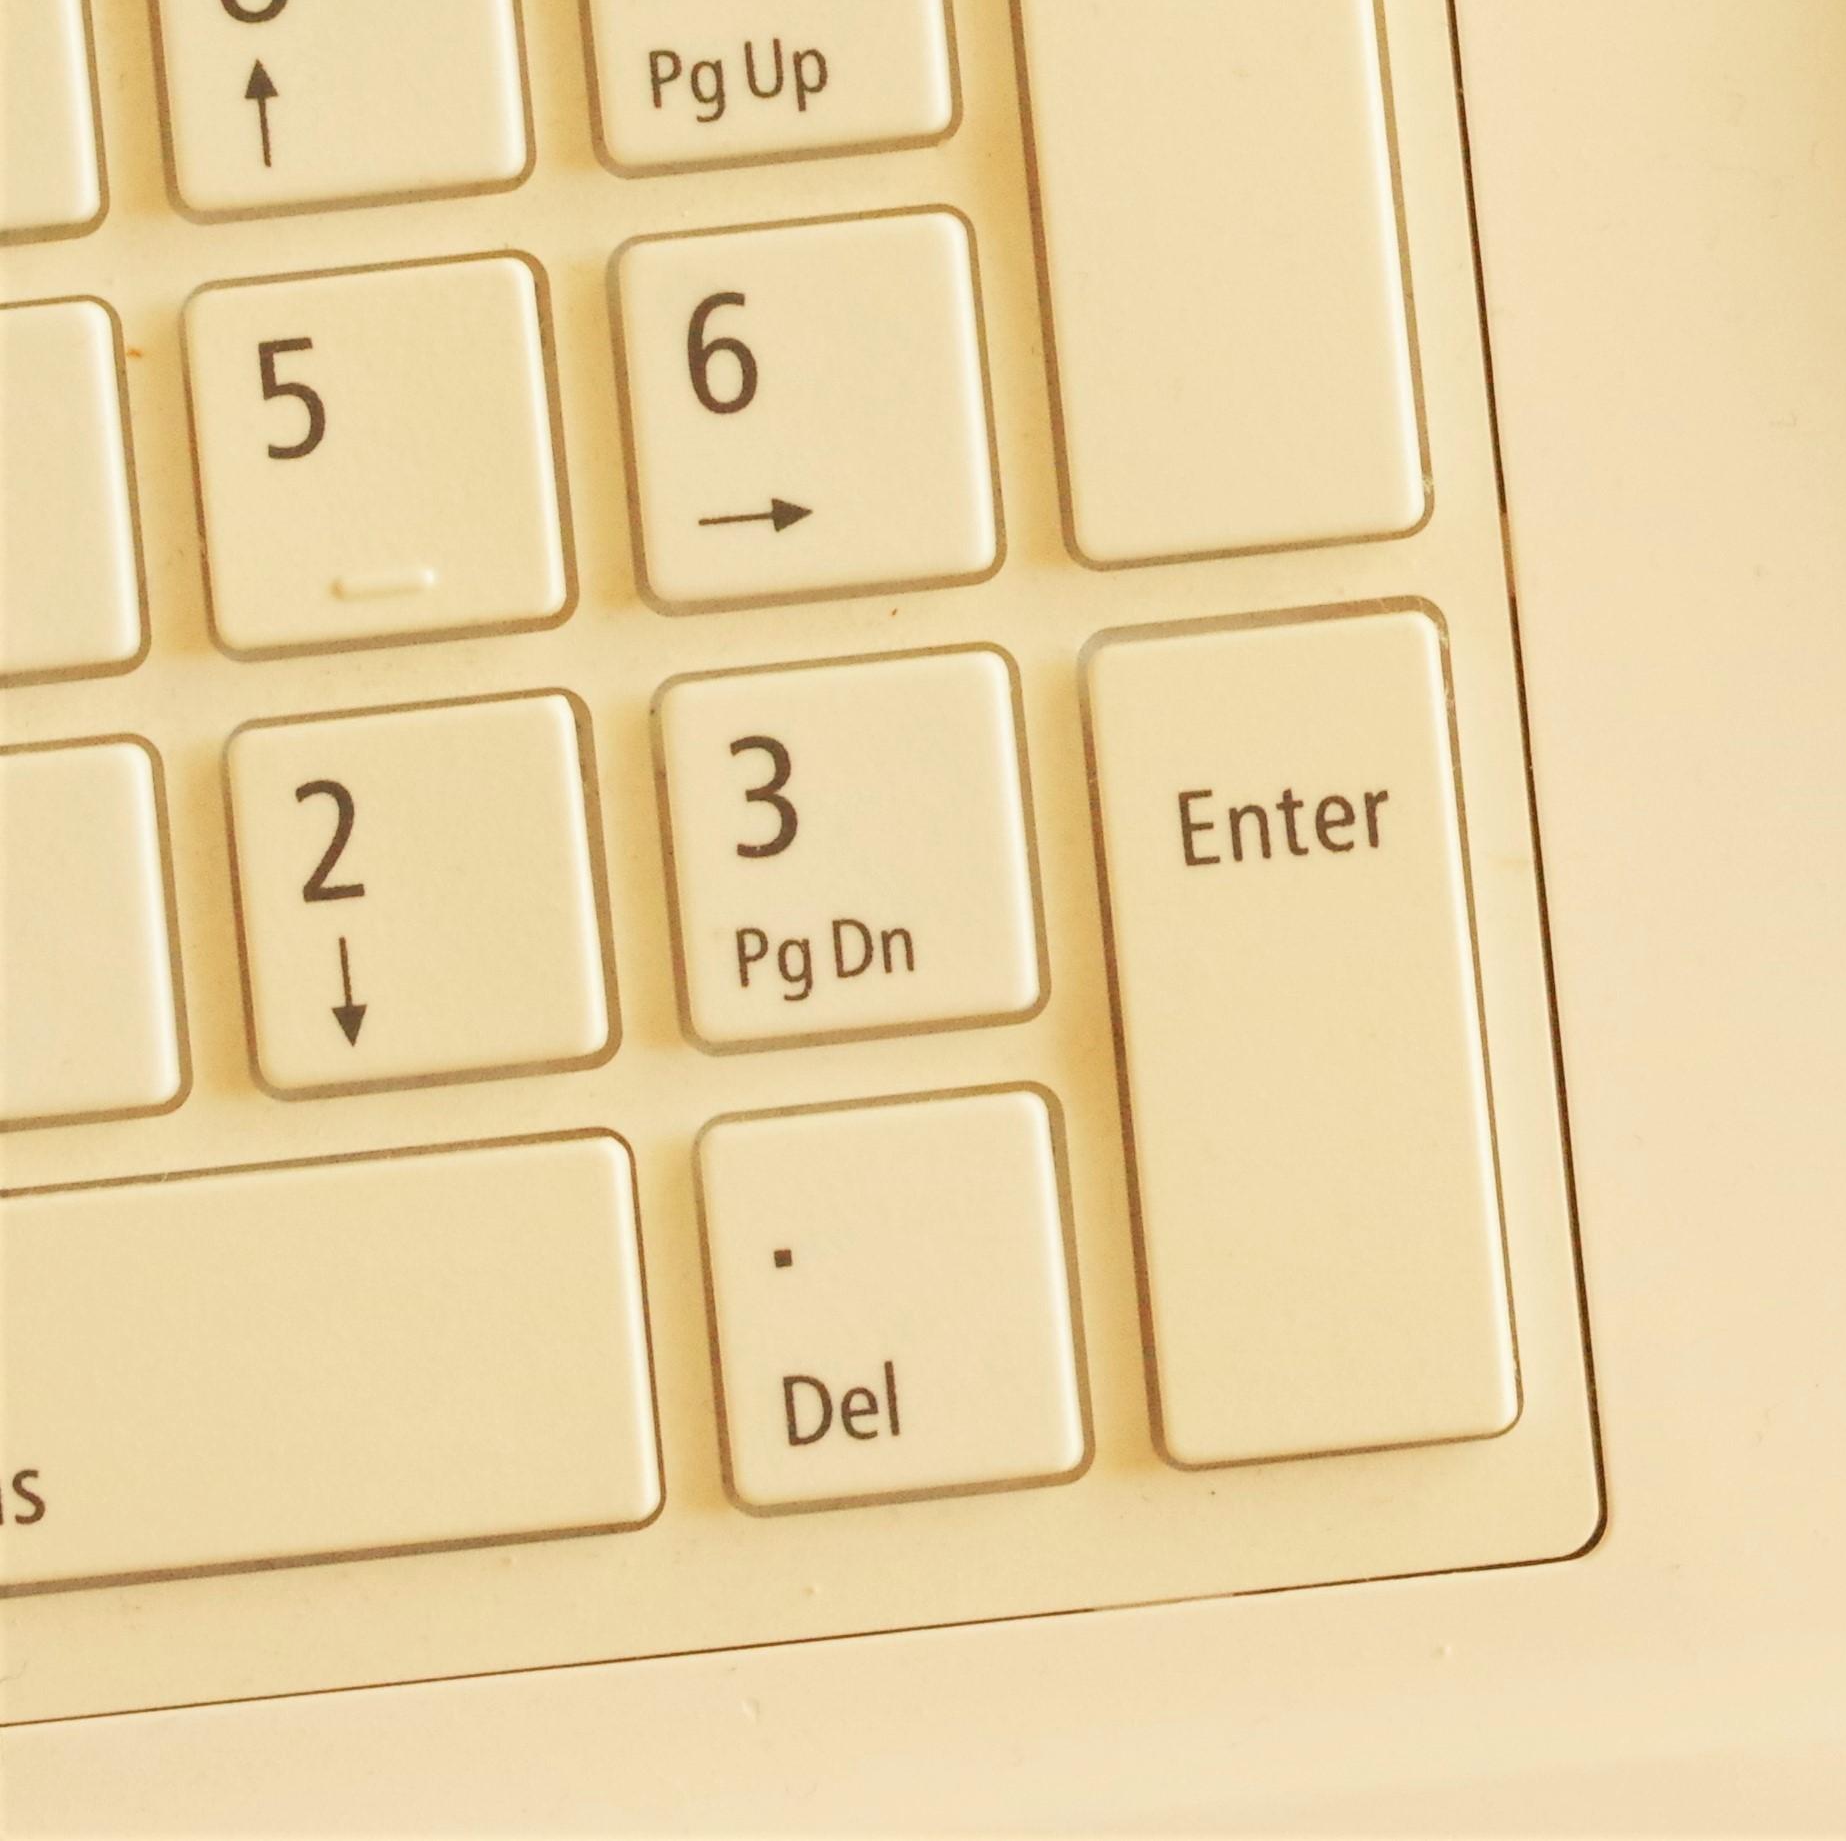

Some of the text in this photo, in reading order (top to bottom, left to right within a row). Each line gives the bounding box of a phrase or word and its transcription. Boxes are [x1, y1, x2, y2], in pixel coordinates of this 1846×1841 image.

[648, 37, 829, 124] Pg Up
[257, 336, 326, 460] 5
[686, 291, 759, 415] 6
[294, 779, 366, 904] 2
[729, 735, 799, 859] 3
[1178, 788, 1390, 867] Enter
[735, 918, 915, 1002] Pg Dn
[782, 1360, 900, 1447] Del
